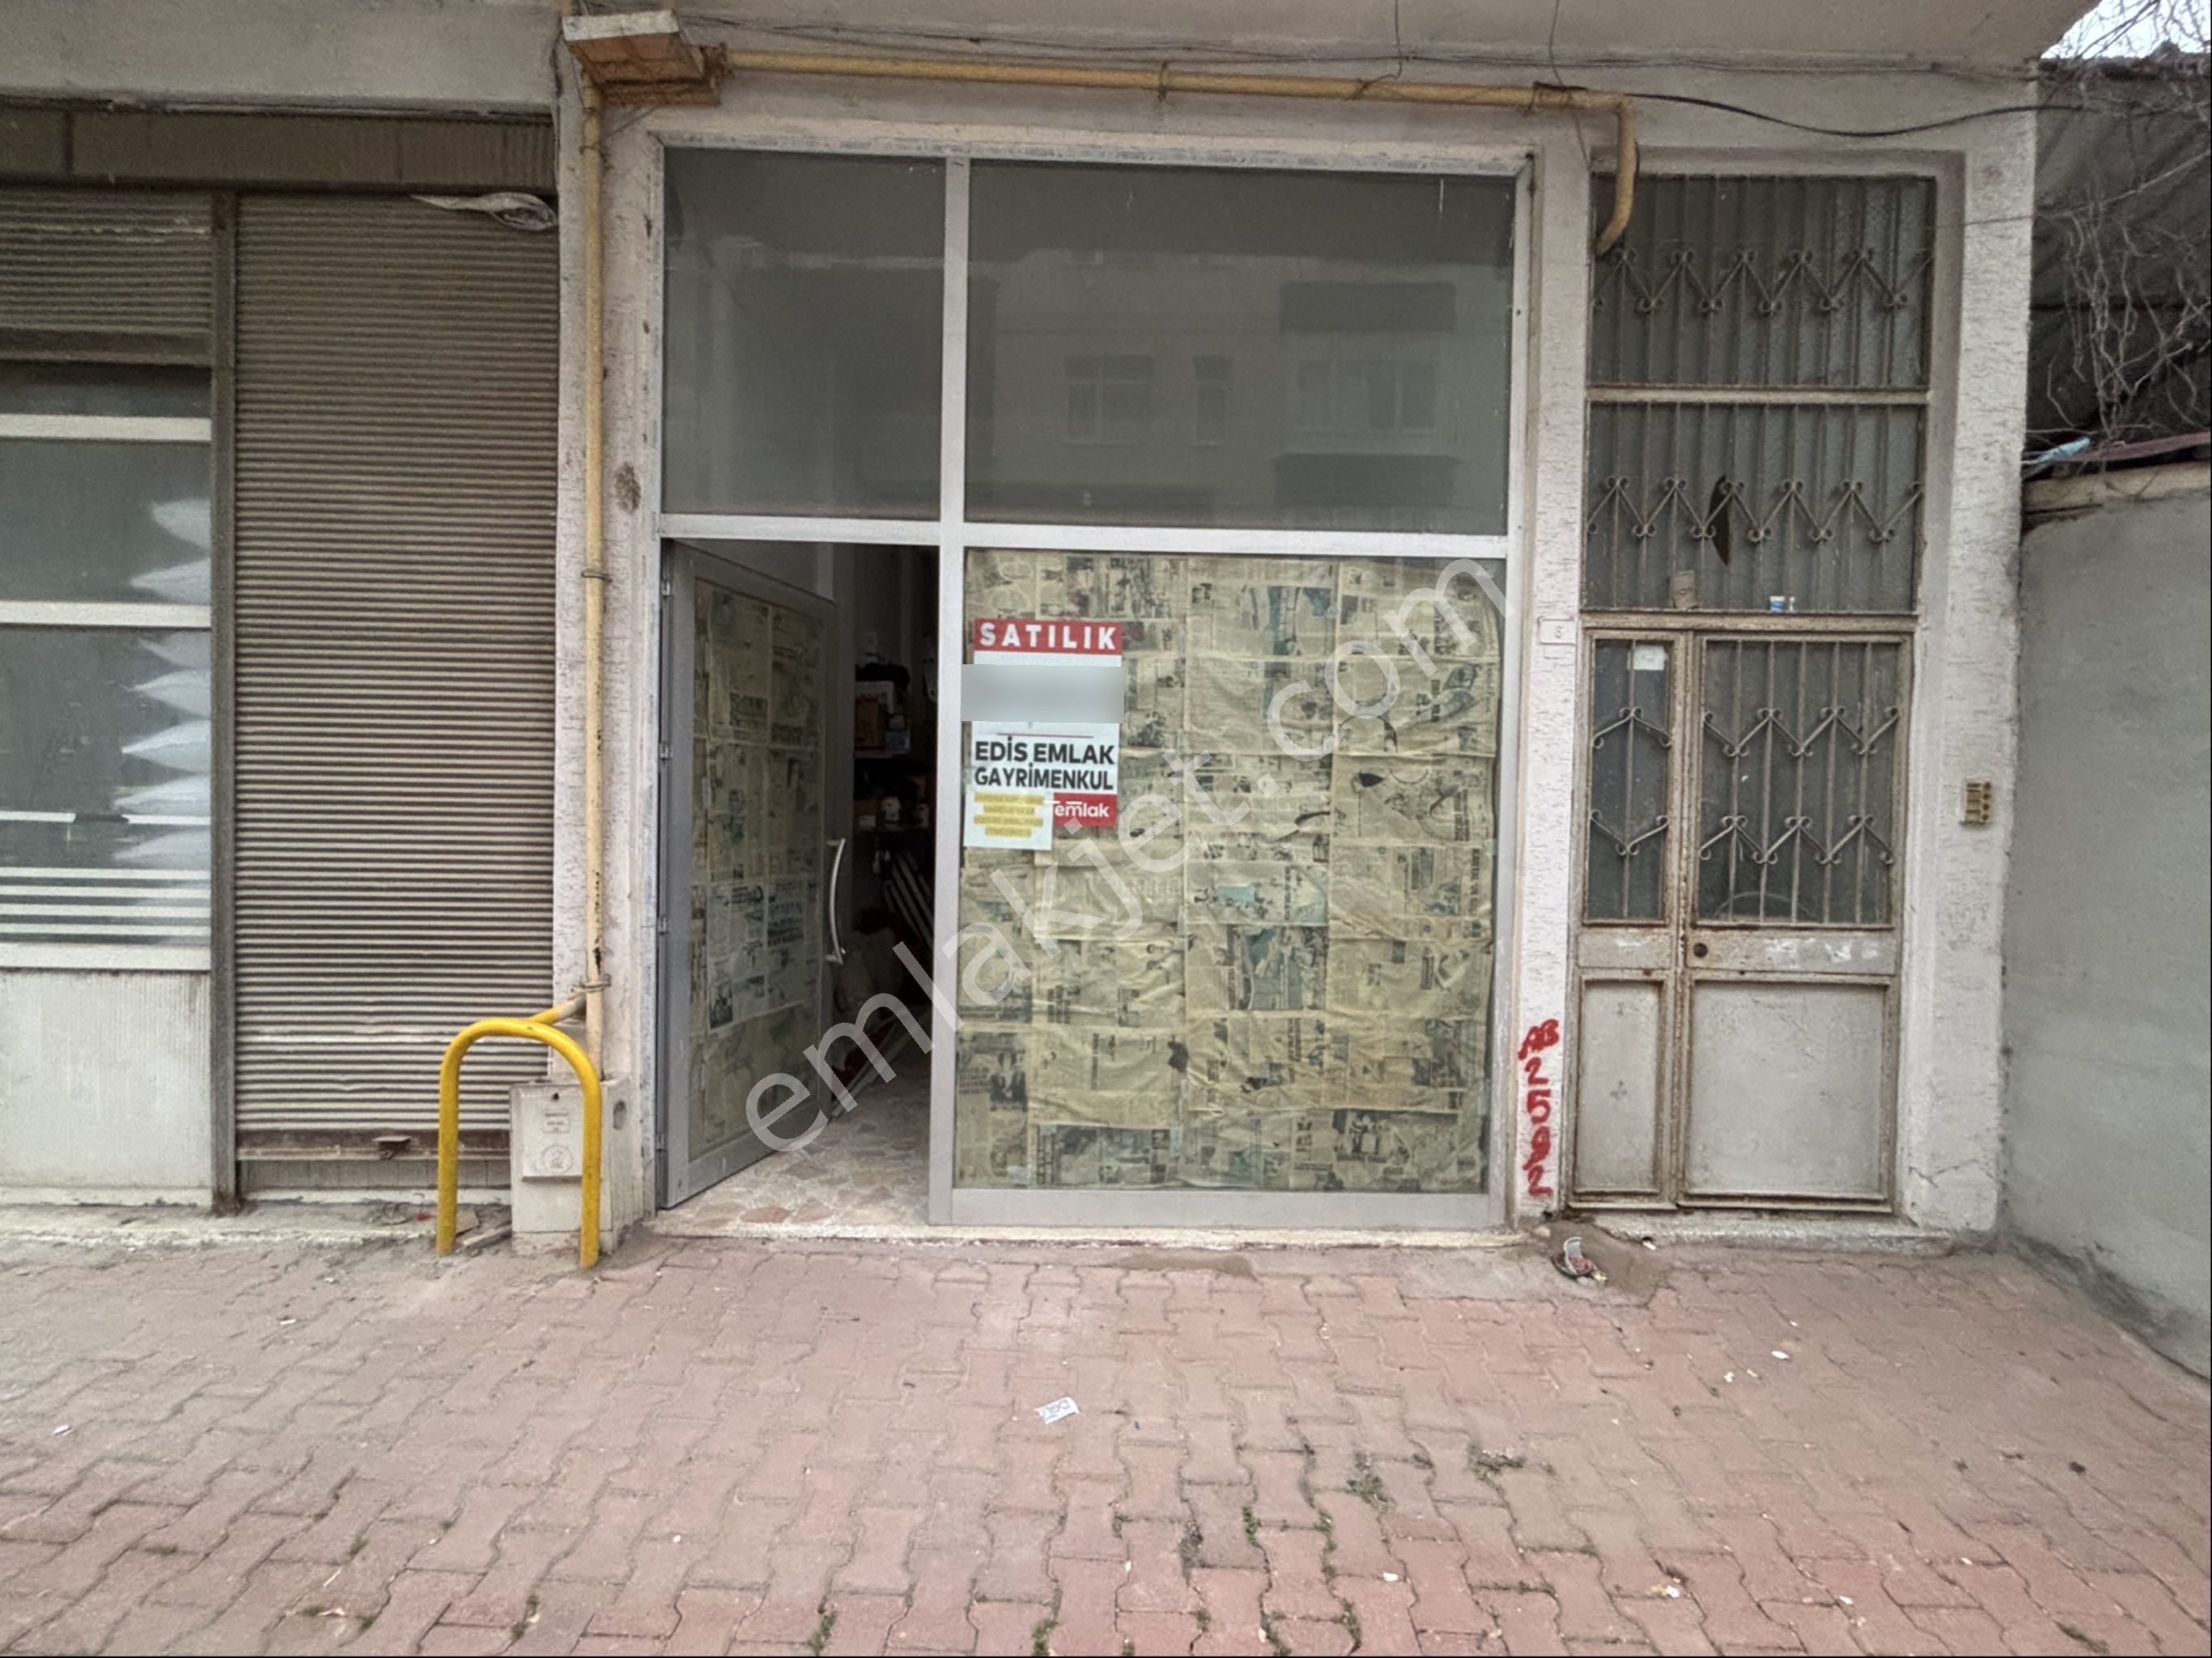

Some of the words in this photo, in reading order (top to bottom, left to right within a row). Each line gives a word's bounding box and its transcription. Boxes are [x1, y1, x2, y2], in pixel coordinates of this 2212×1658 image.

[979, 622, 1116, 651] SATILIK
[974, 736, 1028, 763] EDİS
[1033, 743, 1116, 765] EMLAK
[974, 762, 1114, 791] GAYRİMENKUL
